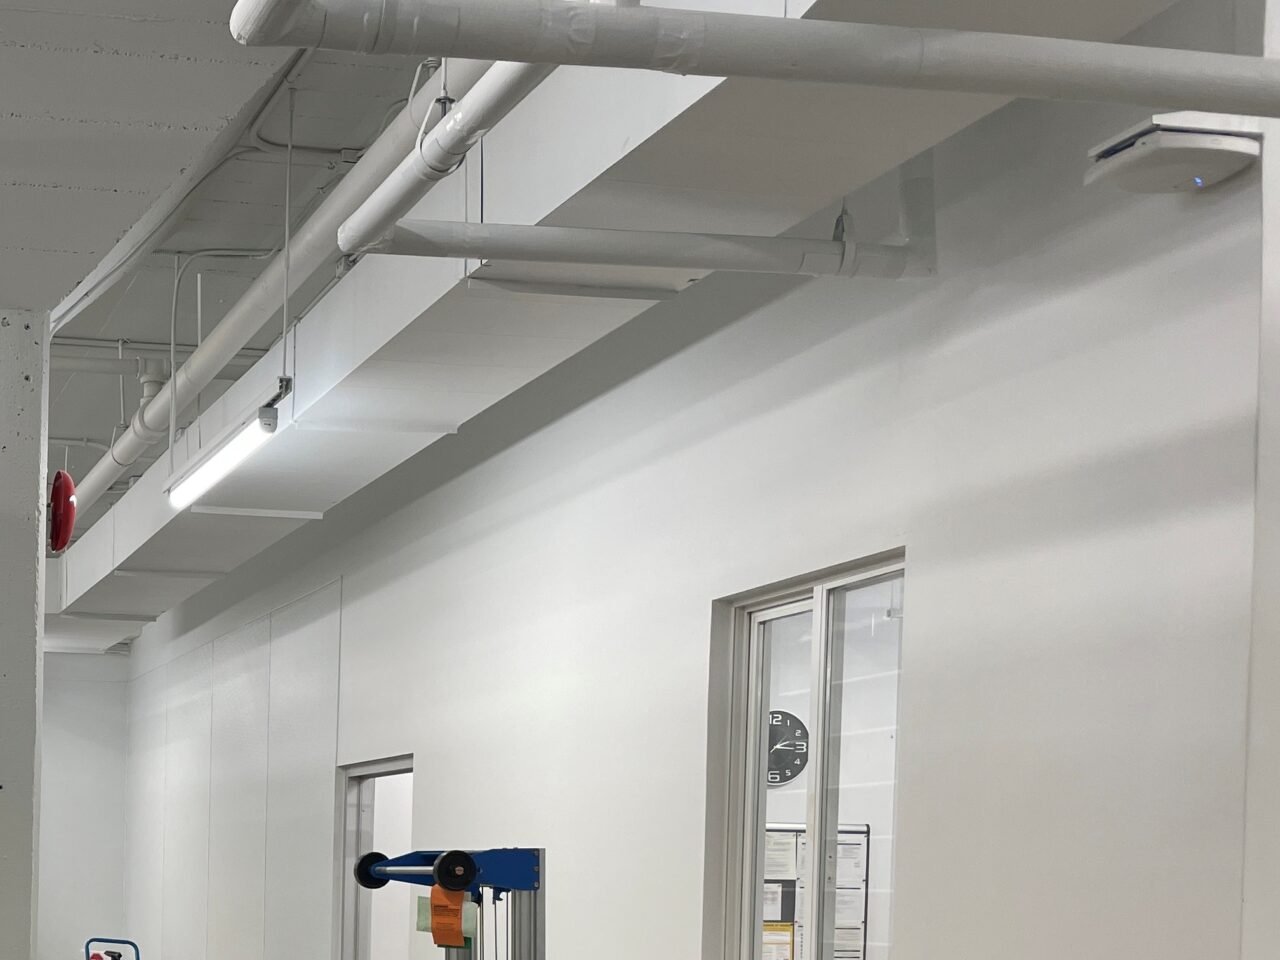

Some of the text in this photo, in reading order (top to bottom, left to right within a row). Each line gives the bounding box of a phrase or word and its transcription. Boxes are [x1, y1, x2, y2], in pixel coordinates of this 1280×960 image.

[769, 714, 782, 725] 12
[795, 742, 807, 753] 3
[768, 770, 780, 782] 6
